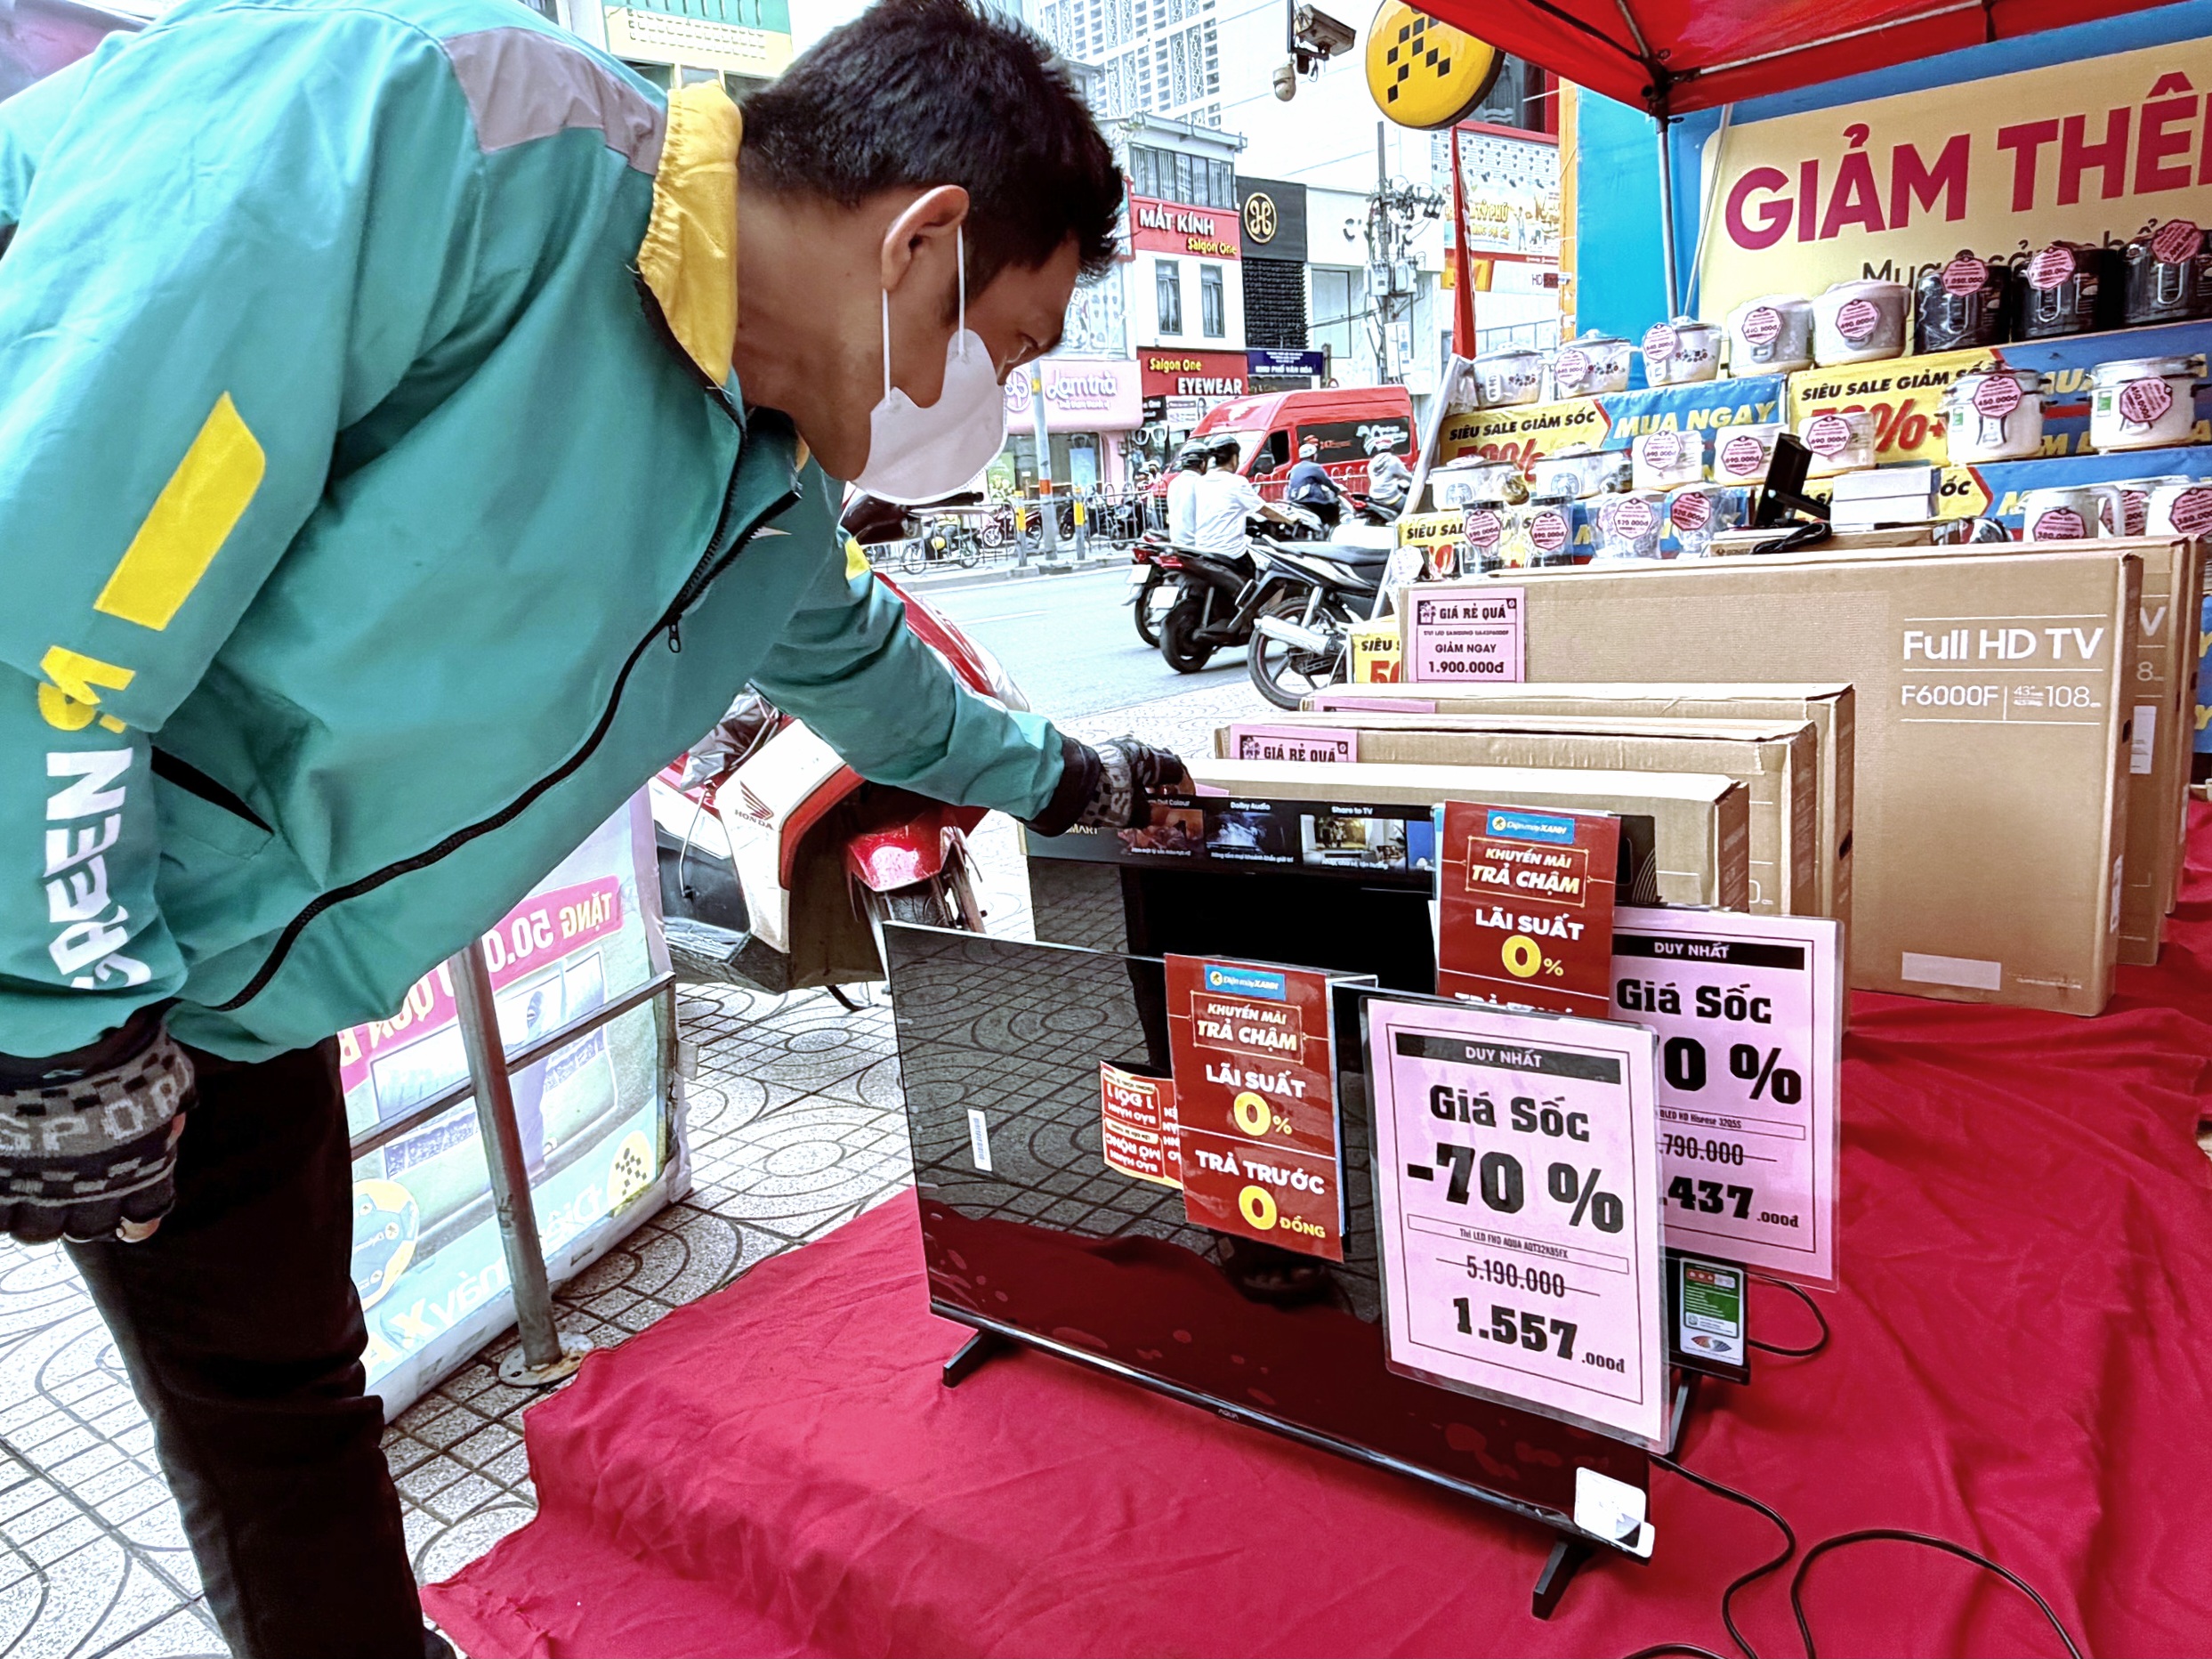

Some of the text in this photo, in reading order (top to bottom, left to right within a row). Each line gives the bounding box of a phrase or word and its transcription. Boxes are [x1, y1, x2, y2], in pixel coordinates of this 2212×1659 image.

[1725, 71, 2212, 250] GIẢM THÊ
[1139, 203, 1215, 237] MẮT KÍNH
[1187, 238, 1238, 256] Saigon One
[1150, 358, 1201, 374] Saigon One
[1177, 376, 1243, 395] EYEWEAR
[1801, 380, 1843, 402] SIÊU
[1845, 378, 1893, 397] SALE
[1896, 368, 1950, 390] GIẢM
[1449, 406, 1596, 441] SIÊU SALE GIẢM SỐC
[1613, 400, 1777, 440] MUA NGAY
[1940, 475, 1972, 498] ỐC
[1407, 523, 1437, 540] SIÊU
[1440, 522, 1465, 537] SAL
[1439, 603, 1506, 621] GIÁ RẺ QUÁ
[1361, 638, 1393, 652] SIÊU
[1435, 641, 1497, 654] GIẢM NGAY
[1903, 627, 2104, 660] Full HD TV
[1429, 660, 1505, 674] 1.900.000đ
[1901, 684, 1999, 708] F6000F
[1263, 744, 1285, 760] GIÁ
[1288, 742, 1306, 762] RẺ
[734, 809, 774, 831] HONDA
[1363, 807, 1373, 815] TV
[42, 748, 152, 990] GREEN
[1485, 846, 1542, 866] KHUYẾN
[1472, 862, 1580, 895] TRẢ CHẬM
[1475, 906, 1584, 941] LÃI SUẤT
[1654, 941, 1730, 959] DUY NHẤT
[1207, 999, 1259, 1023] KHUYẾN
[1616, 977, 1682, 1016] Giá
[1695, 983, 1772, 1024] Sốc
[1197, 1017, 1298, 1055] TRẢ CHẬM
[1465, 1045, 1543, 1069] DUY NHẤT
[1729, 1042, 1802, 1105] %
[1205, 1062, 1307, 1098] LÃI SUẤT
[1429, 1083, 1591, 1143] Giá Sốc
[1659, 1132, 1744, 1166] .790.000
[1195, 1145, 1326, 1195] TRẢ TRƯỚC
[1407, 1142, 1625, 1234] -70 %
[1659, 1175, 1754, 1220] .437
[1239, 1185, 1327, 1239] 0 ĐỒNG
[1473, 1230, 1486, 1242] LED
[1466, 1254, 1565, 1299] 5.190.000
[1452, 1297, 1626, 1374] 1.557 .000đ
